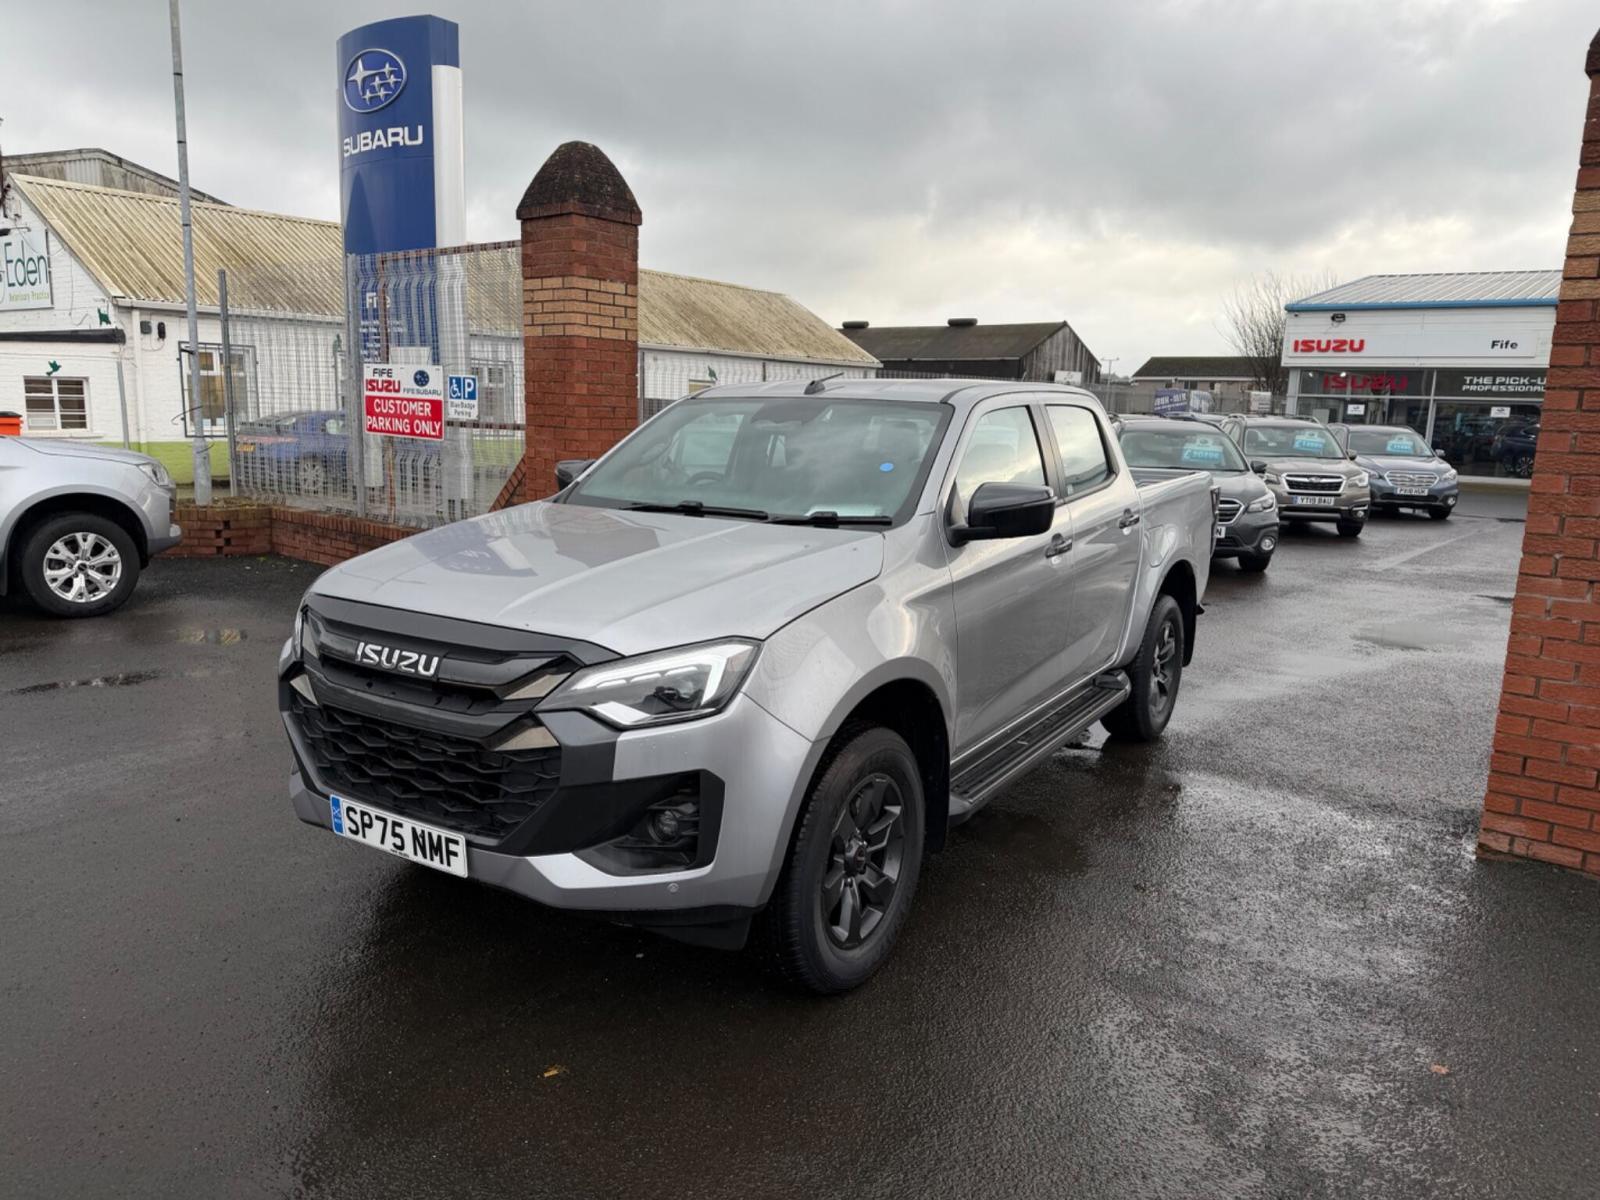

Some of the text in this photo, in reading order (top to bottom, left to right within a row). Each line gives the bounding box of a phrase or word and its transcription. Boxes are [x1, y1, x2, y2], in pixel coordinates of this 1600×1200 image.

[343, 125, 424, 157] SUBARU
[4, 240, 49, 287] Eden
[1293, 339, 1366, 353] ISUZU
[1490, 340, 1518, 350] Fife
[372, 367, 394, 378] FIFE
[1463, 376, 1493, 385] THE
[365, 378, 401, 393] ISUZU
[464, 378, 475, 399] P
[373, 398, 432, 417] CUSTOMER
[366, 415, 441, 436] PARKING ONLY
[356, 642, 440, 677] ISUZU
[346, 806, 460, 868] SP75 NMF
